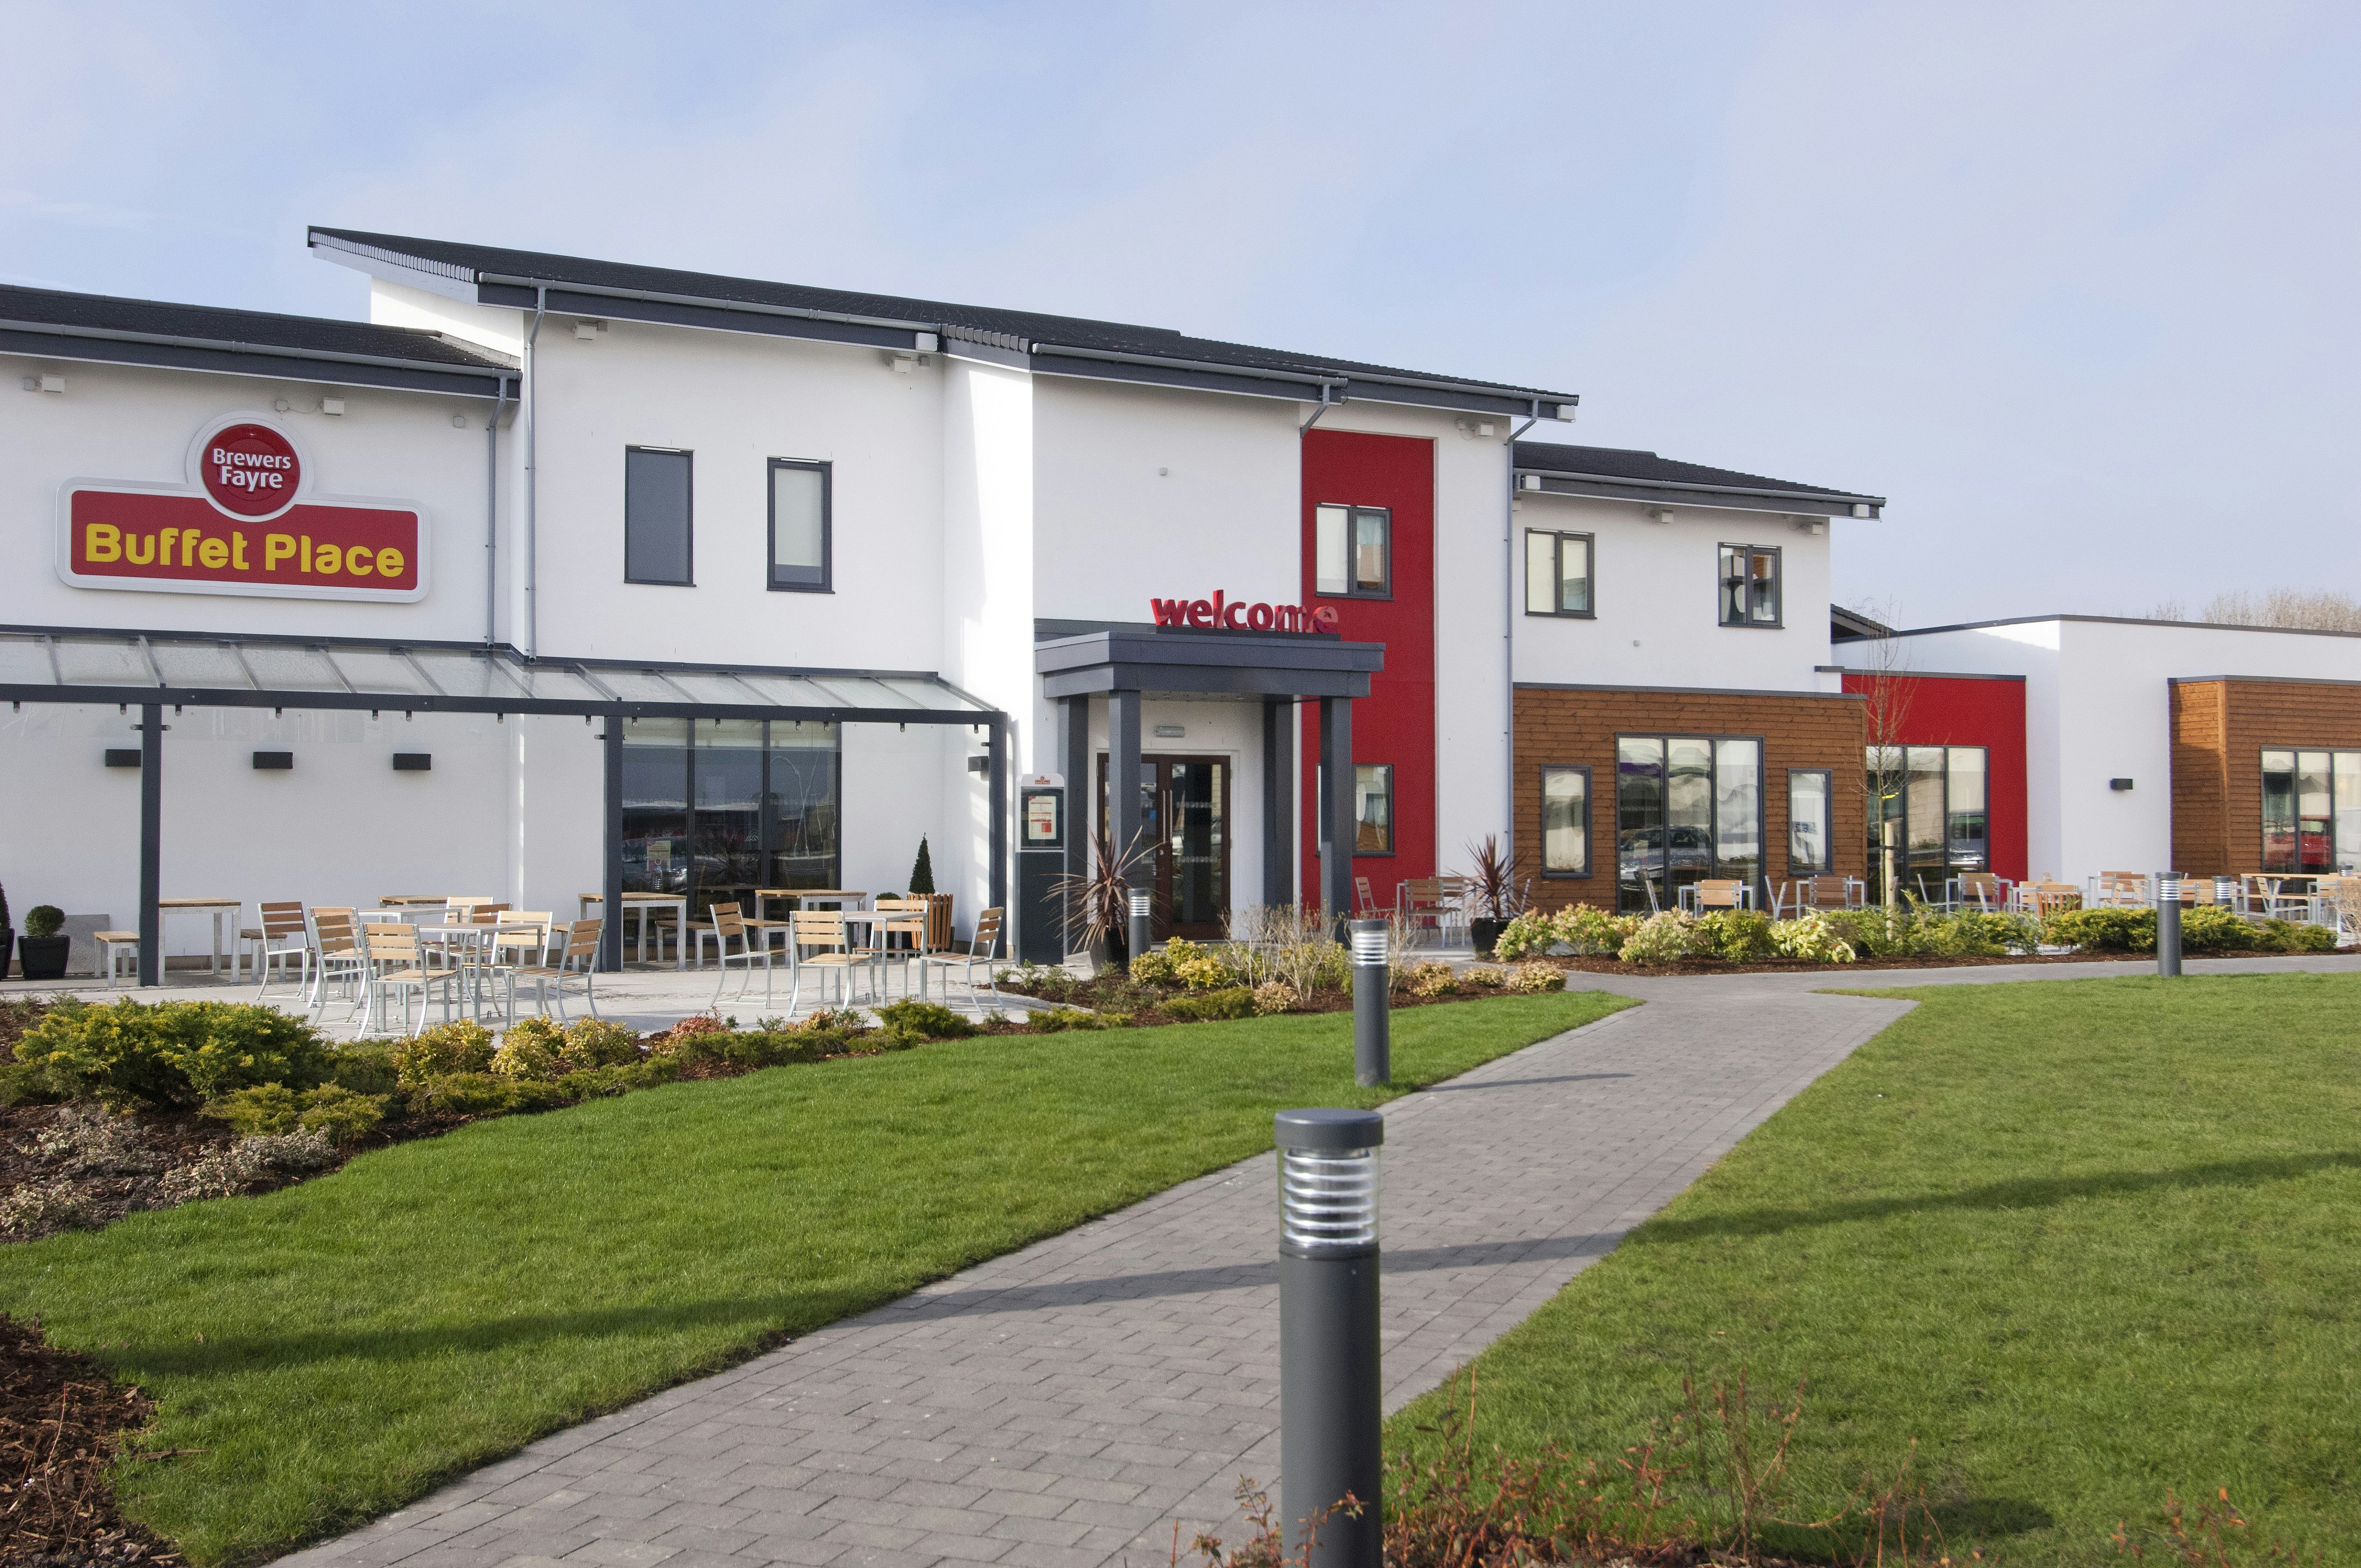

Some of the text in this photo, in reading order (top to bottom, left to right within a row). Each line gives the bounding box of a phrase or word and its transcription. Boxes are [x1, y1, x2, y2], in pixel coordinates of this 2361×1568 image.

[213, 448, 291, 469] Brewers
[221, 466, 283, 492] Fayre
[86, 523, 405, 578] Buffet Place
[1150, 589, 1339, 634] welcome
